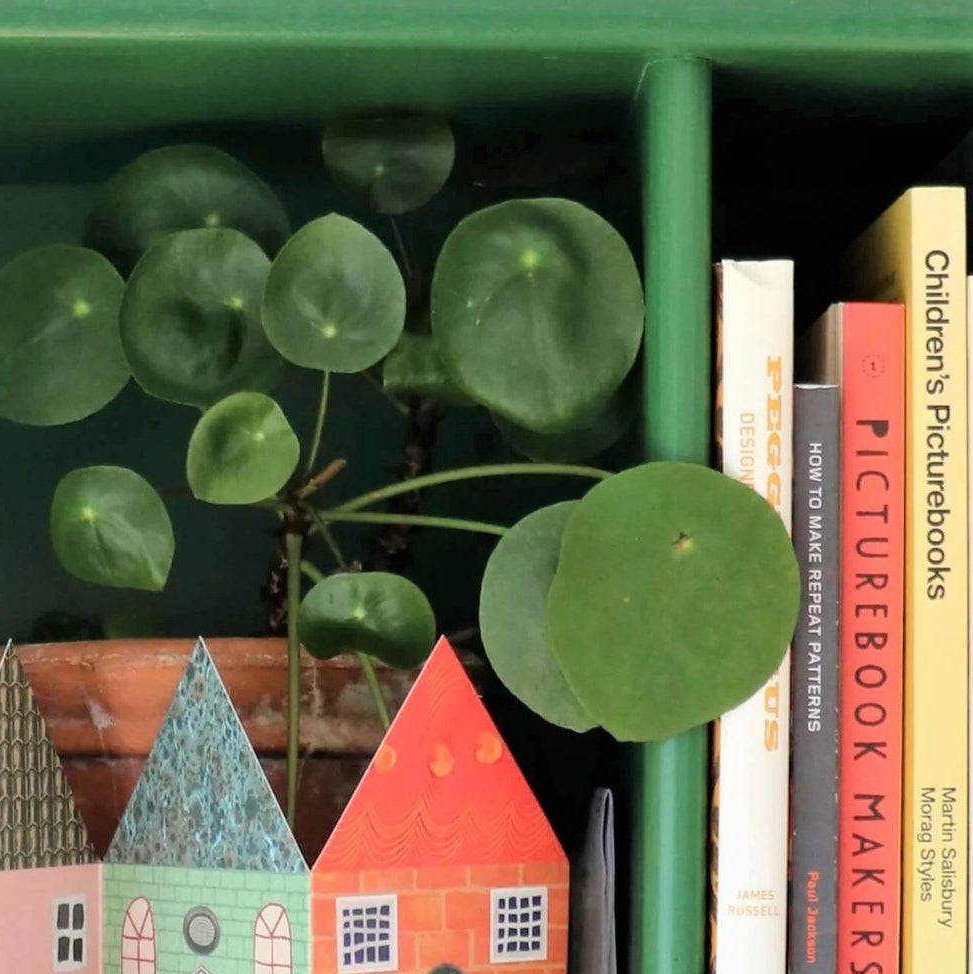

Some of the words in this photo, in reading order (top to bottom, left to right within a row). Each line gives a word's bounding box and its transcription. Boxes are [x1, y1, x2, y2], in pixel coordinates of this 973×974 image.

[926, 250, 951, 395] Children's
[766, 356, 783, 518] PEGG
[808, 442, 823, 481] HOW
[808, 487, 823, 510] TO
[926, 404, 951, 601] Picturebooks
[808, 515, 823, 563] MAKE
[808, 569, 823, 636] REPEAT
[853, 419, 890, 761] PICTUREBOOK
[807, 642, 822, 733] PATTERNS
[916, 786, 936, 843] Morag
[940, 786, 957, 842] Martin
[736, 890, 776, 901] JAMES
[806, 872, 820, 902] Paul
[917, 848, 936, 902] Styles
[937, 848, 957, 929] Salisbury
[727, 904, 780, 917] RUSSELL
[806, 906, 820, 964] Jackson
